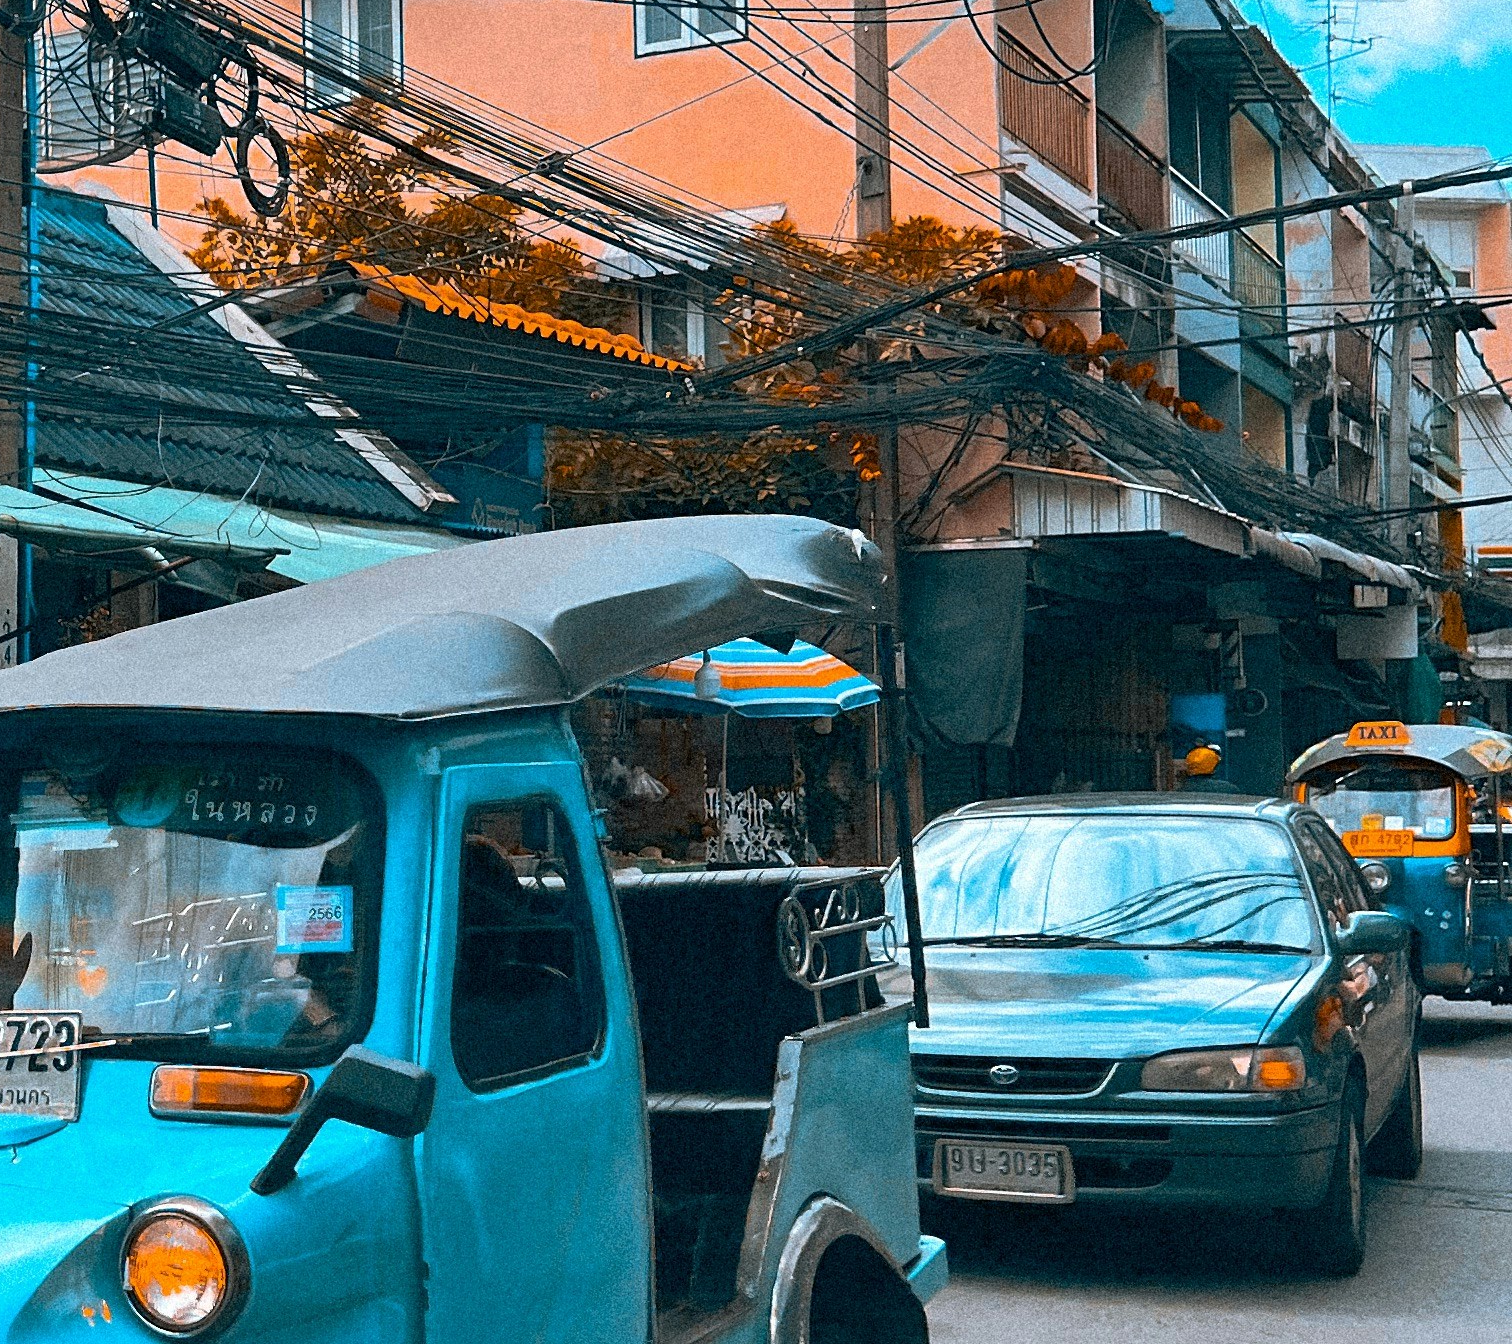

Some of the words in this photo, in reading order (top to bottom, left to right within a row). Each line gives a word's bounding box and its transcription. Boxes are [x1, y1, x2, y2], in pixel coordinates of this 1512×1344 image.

[1358, 726, 1399, 741] TAXI
[185, 788, 318, 826] ในหลวง
[308, 905, 342, 921] 2566
